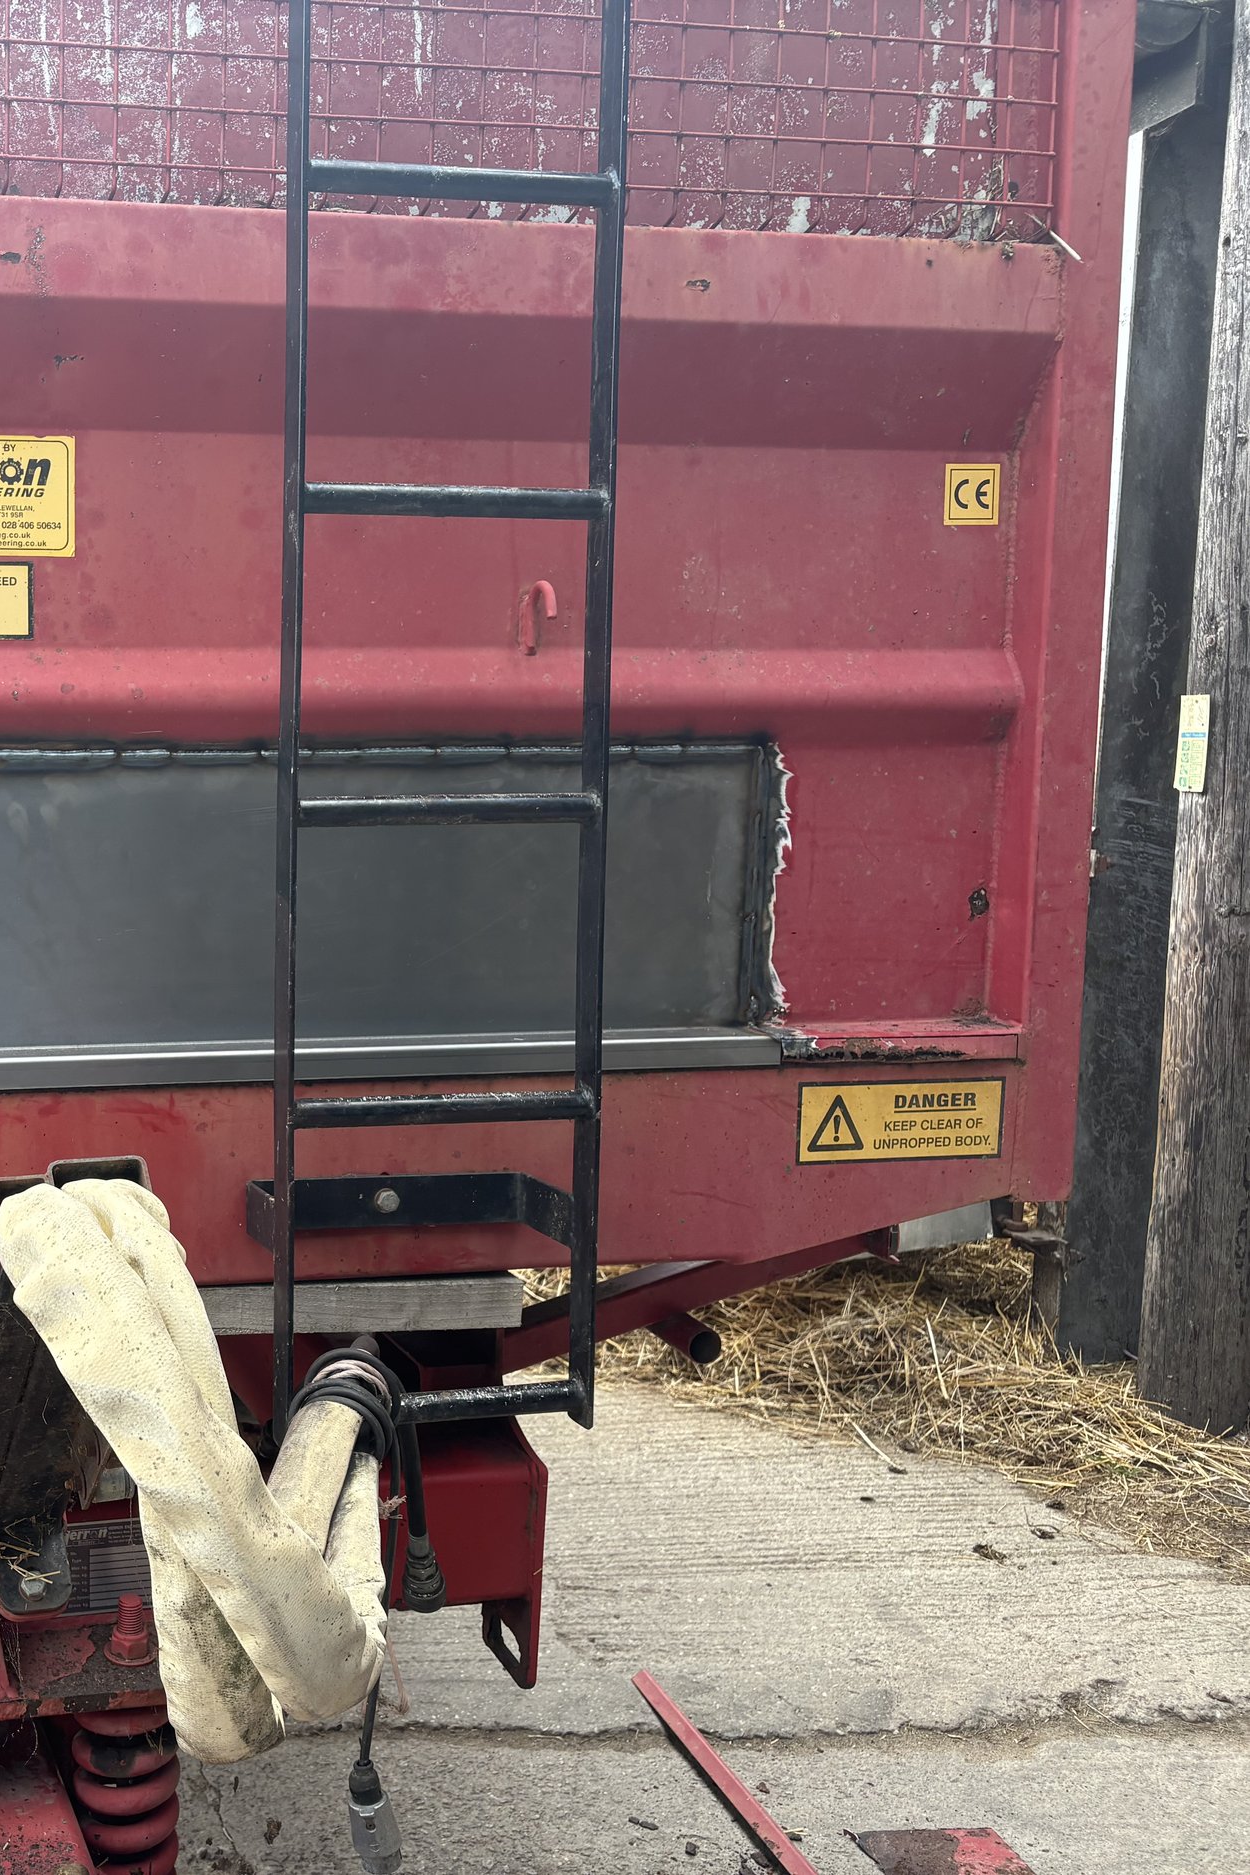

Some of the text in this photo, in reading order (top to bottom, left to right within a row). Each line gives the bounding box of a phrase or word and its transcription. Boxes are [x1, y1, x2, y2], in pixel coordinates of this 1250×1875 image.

[3, 443, 17, 452] BY
[954, 478, 991, 510] CE
[1, 521, 18, 529] 028
[19, 521, 35, 530] 406
[36, 522, 62, 530] 50634
[894, 1092, 977, 1109] DANGER
[884, 1117, 983, 1132] KEEP CLEAR OF
[873, 1134, 991, 1150] UNPROPPED BODY.
